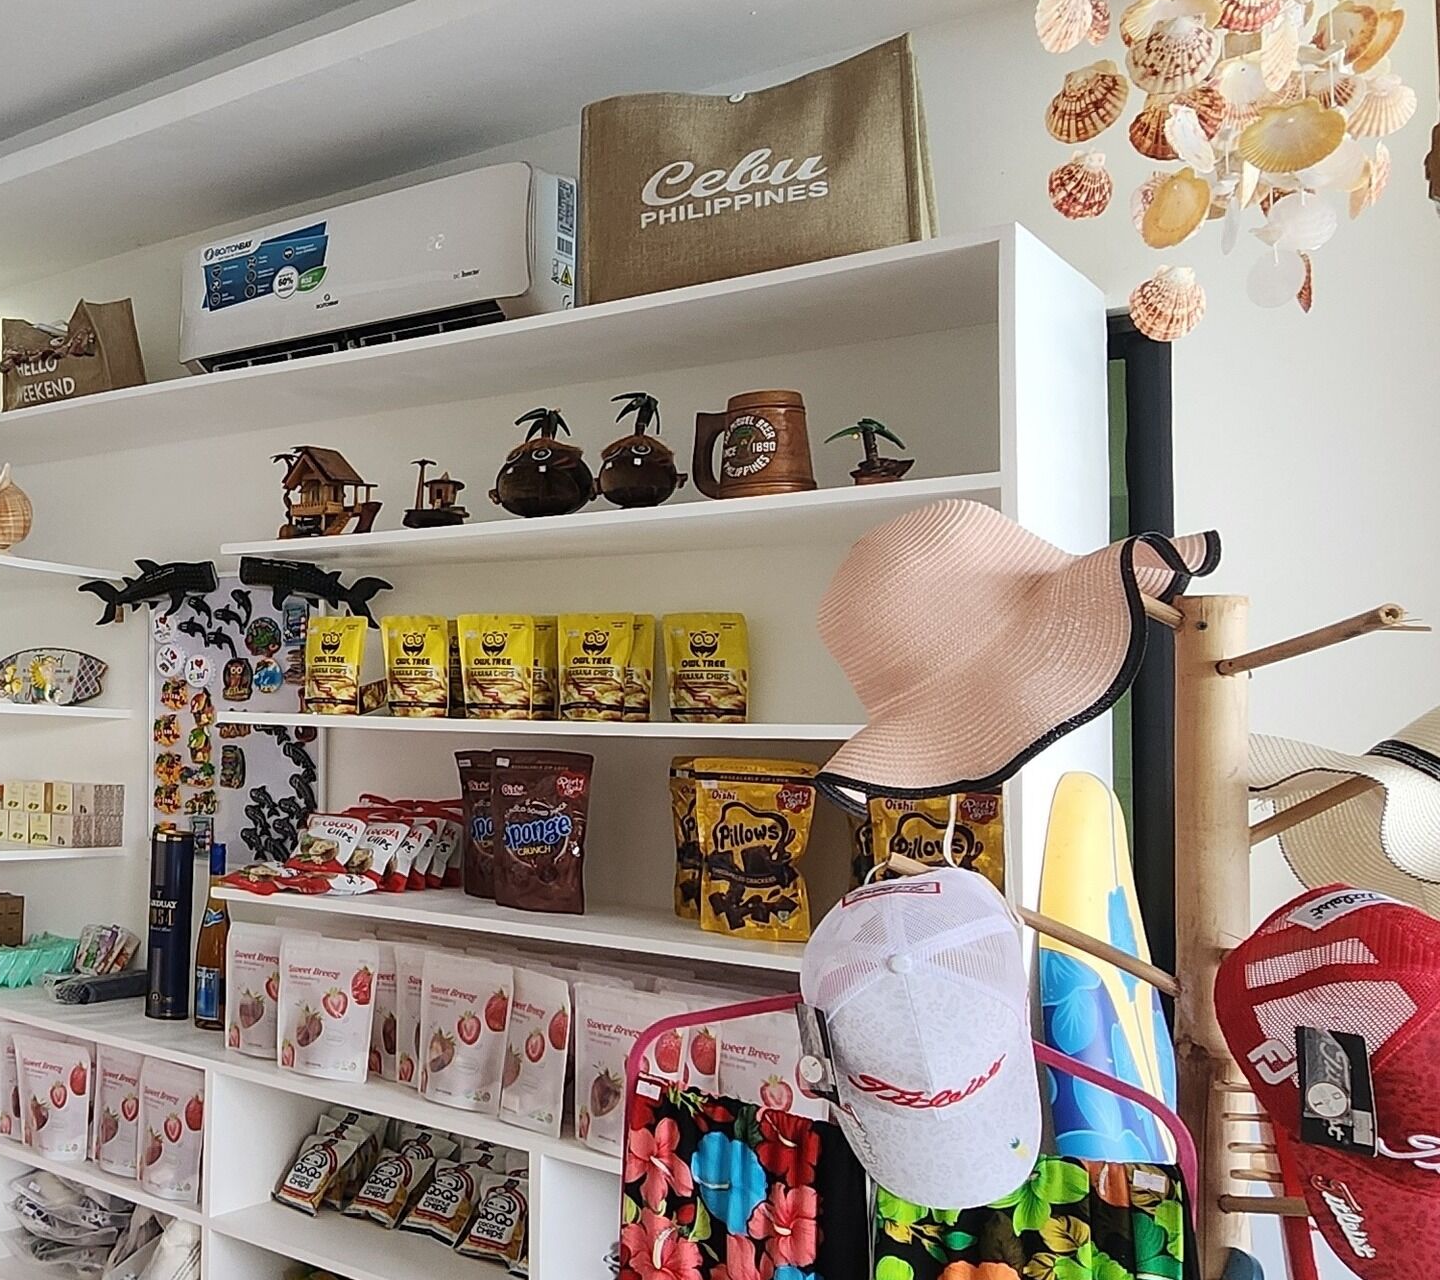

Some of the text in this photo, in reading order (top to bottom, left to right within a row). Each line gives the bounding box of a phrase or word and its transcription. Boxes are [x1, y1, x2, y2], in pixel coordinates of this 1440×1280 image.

[640, 147, 828, 206] Cebu
[640, 180, 829, 229] PHILIPPINES
[15, 358, 58, 377] HELLO
[328, 656, 345, 664] TREE
[410, 658, 430, 666] TREE
[491, 658, 511, 666] TREE
[592, 657, 612, 665] TREE
[701, 660, 725, 668] TREE
[712, 790, 736, 800] Oishi
[885, 799, 914, 811] Oishi
[962, 798, 996, 814] Party
[719, 823, 779, 849] Pillows
[517, 845, 551, 856] CRUNCH
[235, 949, 256, 961] Sweet
[257, 952, 279, 965] Breez
[288, 964, 311, 975] Sweet
[431, 983, 449, 995] Sweet
[586, 1018, 612, 1031] Sweet
[613, 1025, 641, 1040] Breez
[748, 1046, 780, 1064] Breeze
